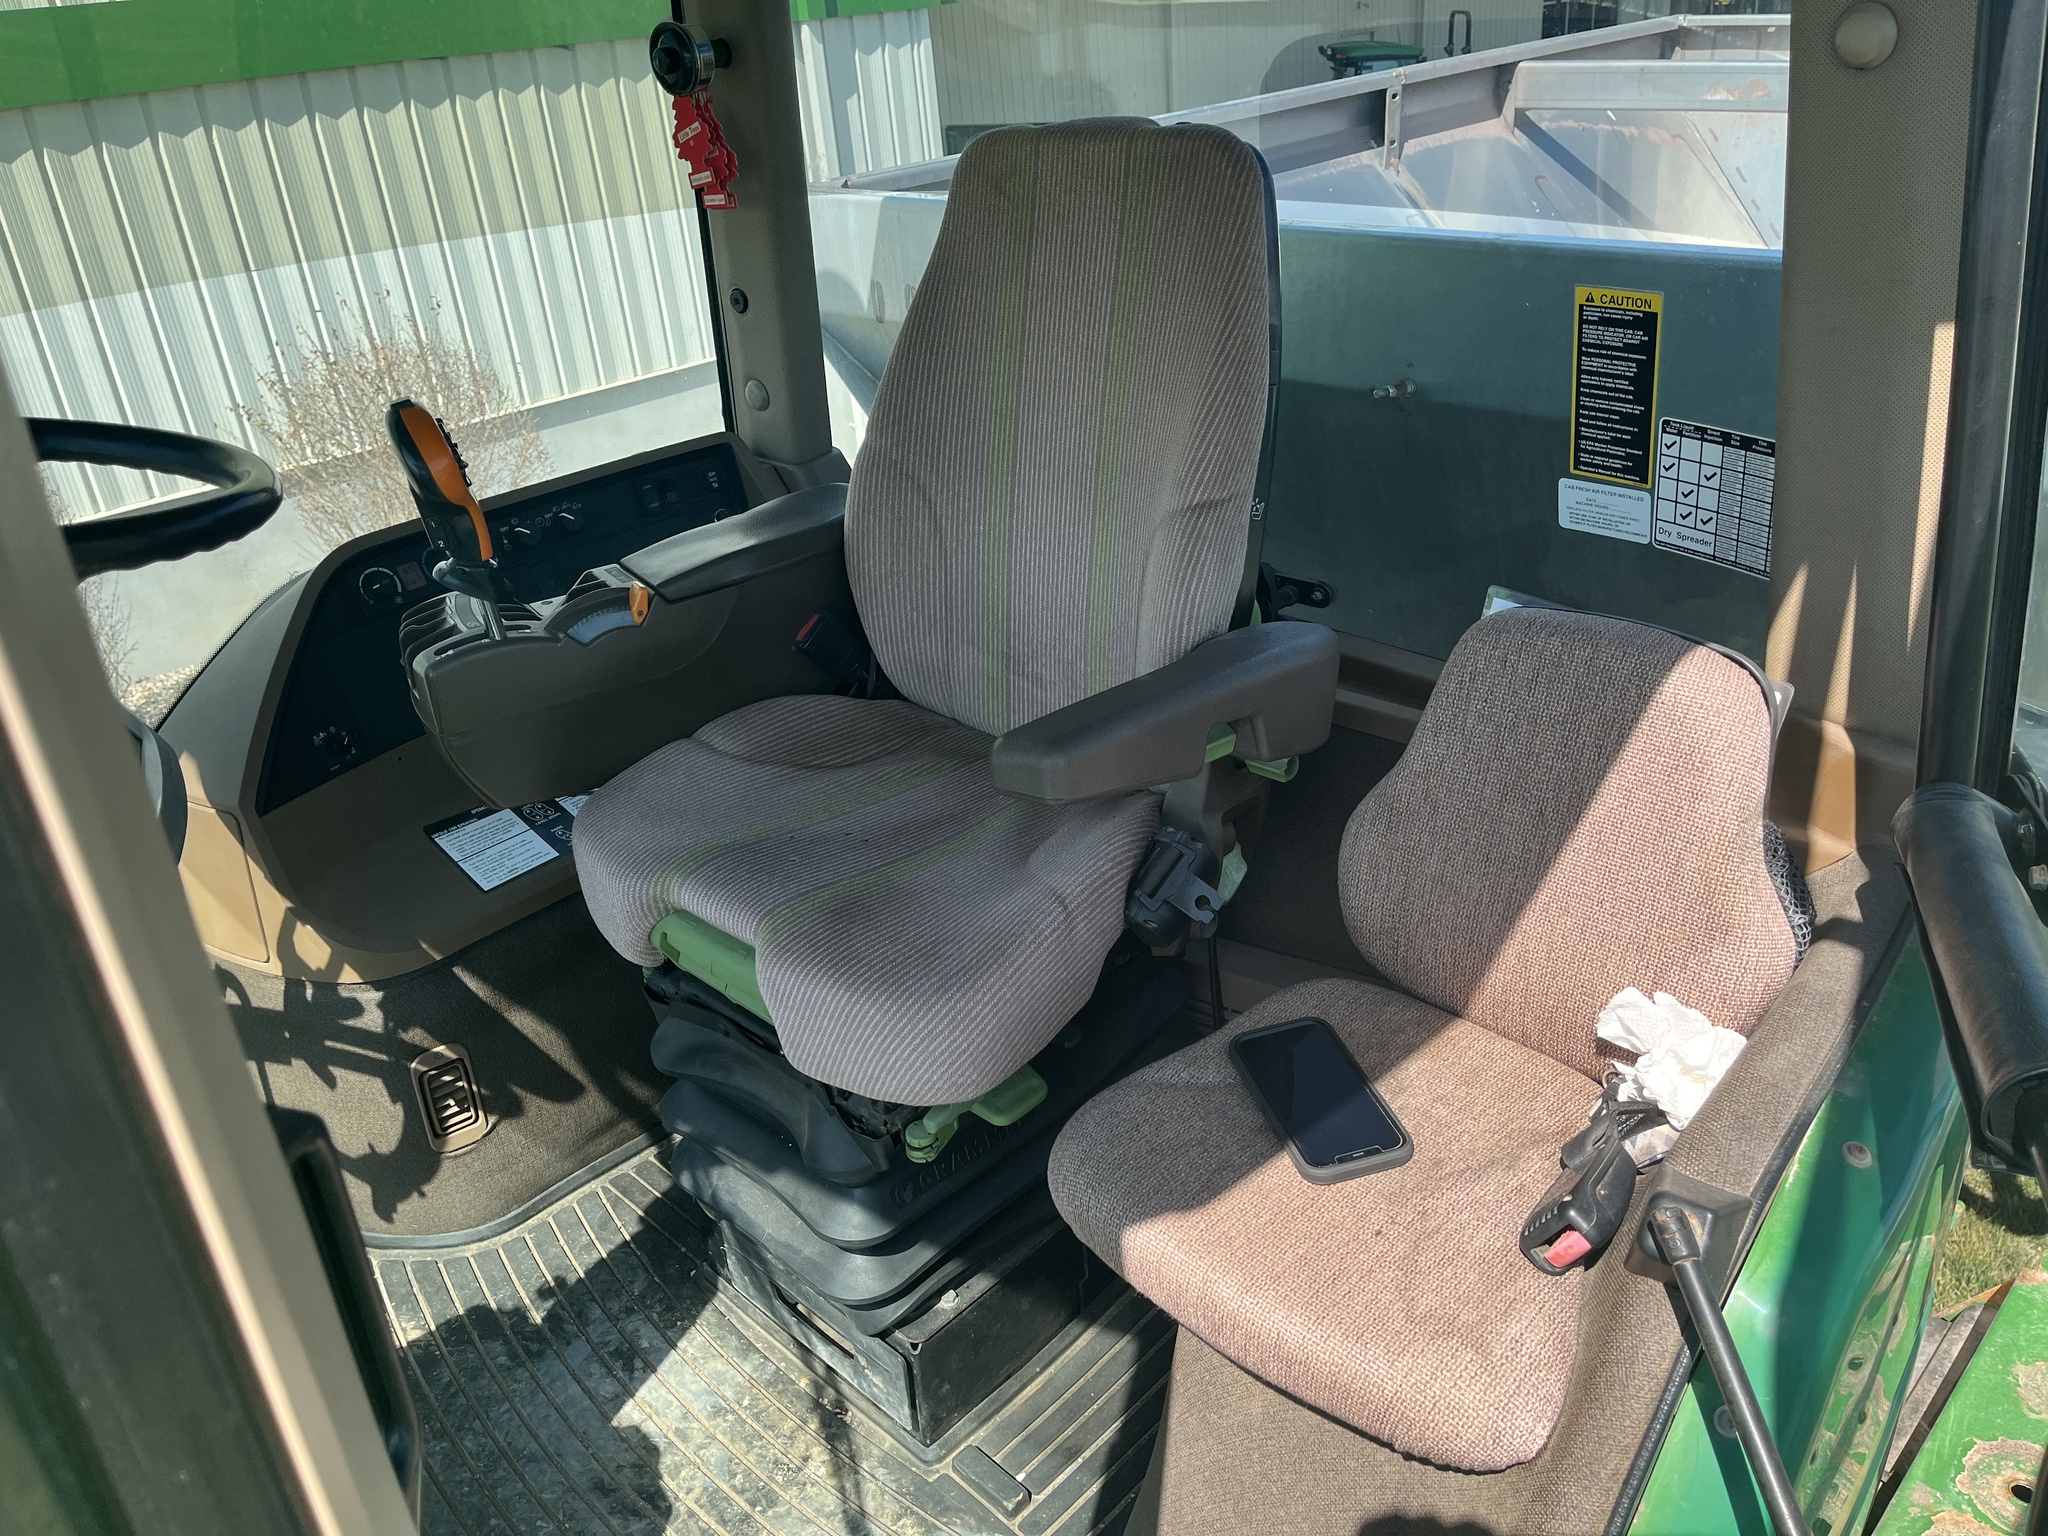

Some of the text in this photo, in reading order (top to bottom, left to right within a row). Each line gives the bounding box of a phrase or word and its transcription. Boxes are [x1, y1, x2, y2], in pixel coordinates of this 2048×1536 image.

[1600, 294, 1653, 309] CAUTION
[1704, 435, 1722, 443] Injection
[1752, 445, 1771, 453] Pressure
[1618, 493, 1644, 502] INSTALLED
[1658, 527, 1713, 550] Dry Spreader
